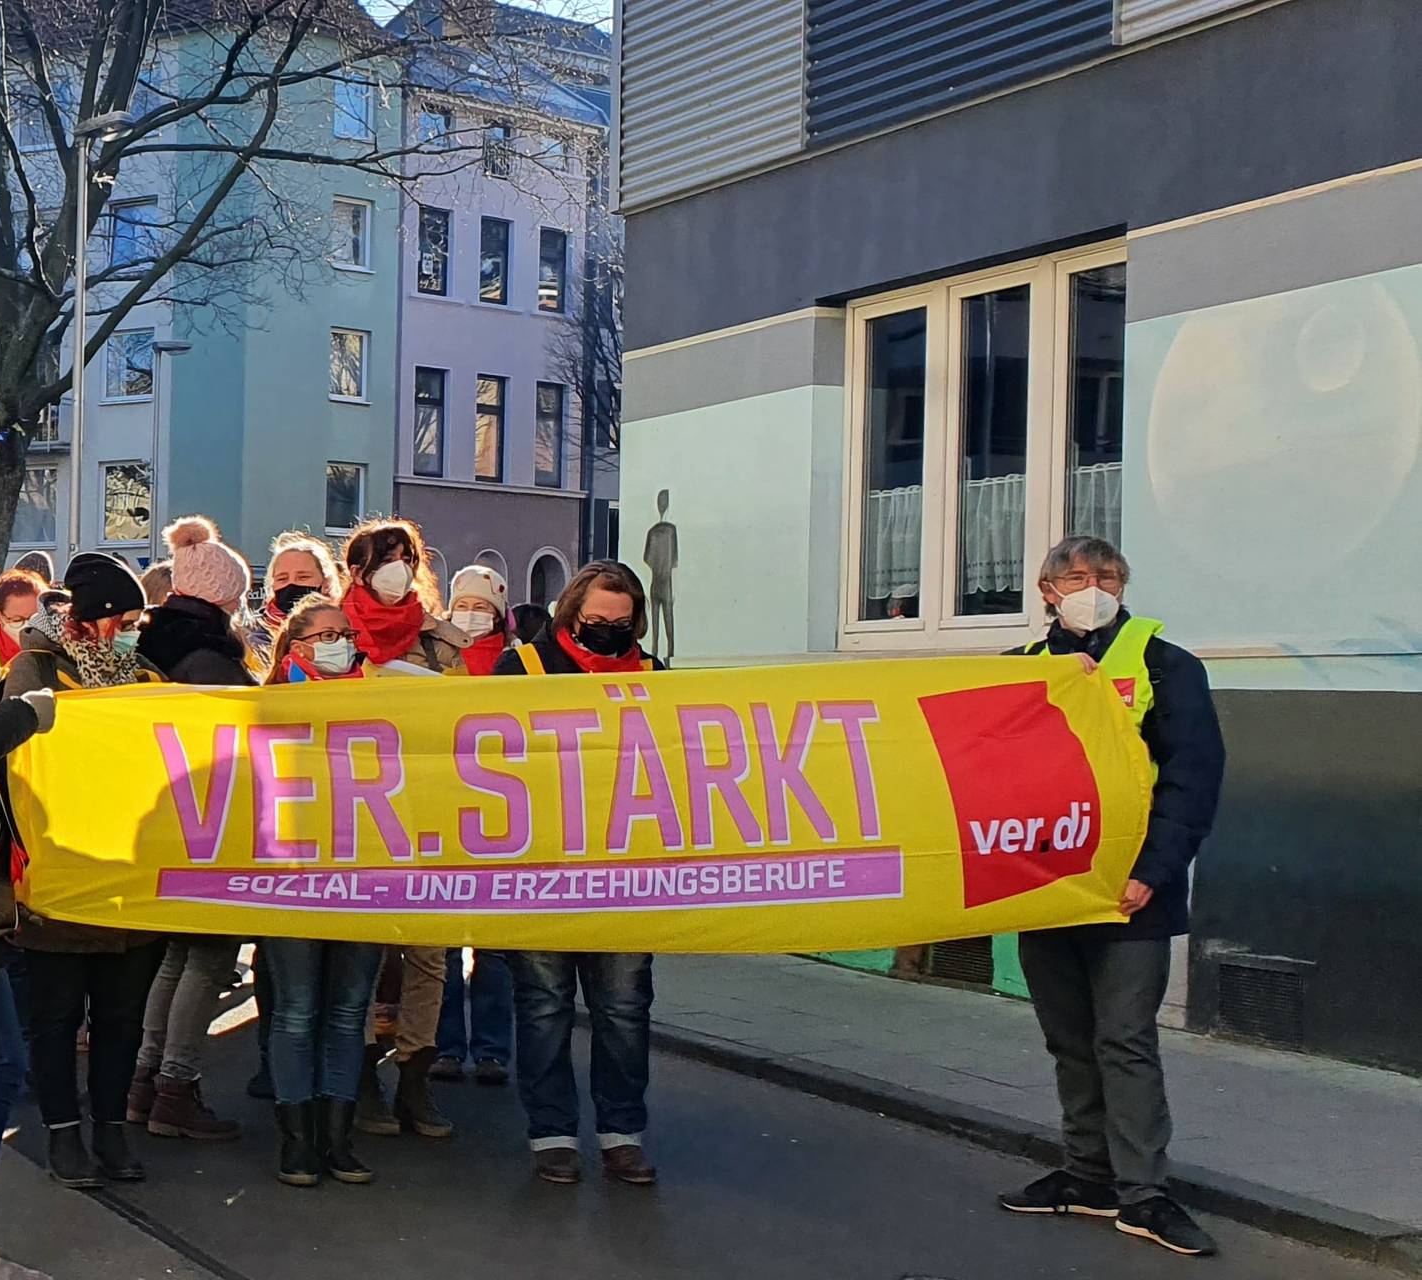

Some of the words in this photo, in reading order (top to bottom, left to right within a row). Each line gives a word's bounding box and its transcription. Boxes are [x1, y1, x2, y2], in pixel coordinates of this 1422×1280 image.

[153, 683, 881, 863] VER.STÄRKT
[969, 802, 1091, 855] ver.di
[226, 872, 389, 901] SOZIAL-
[405, 874, 476, 901] UND
[490, 860, 846, 900] ERZIEHUNGSBERUFE
